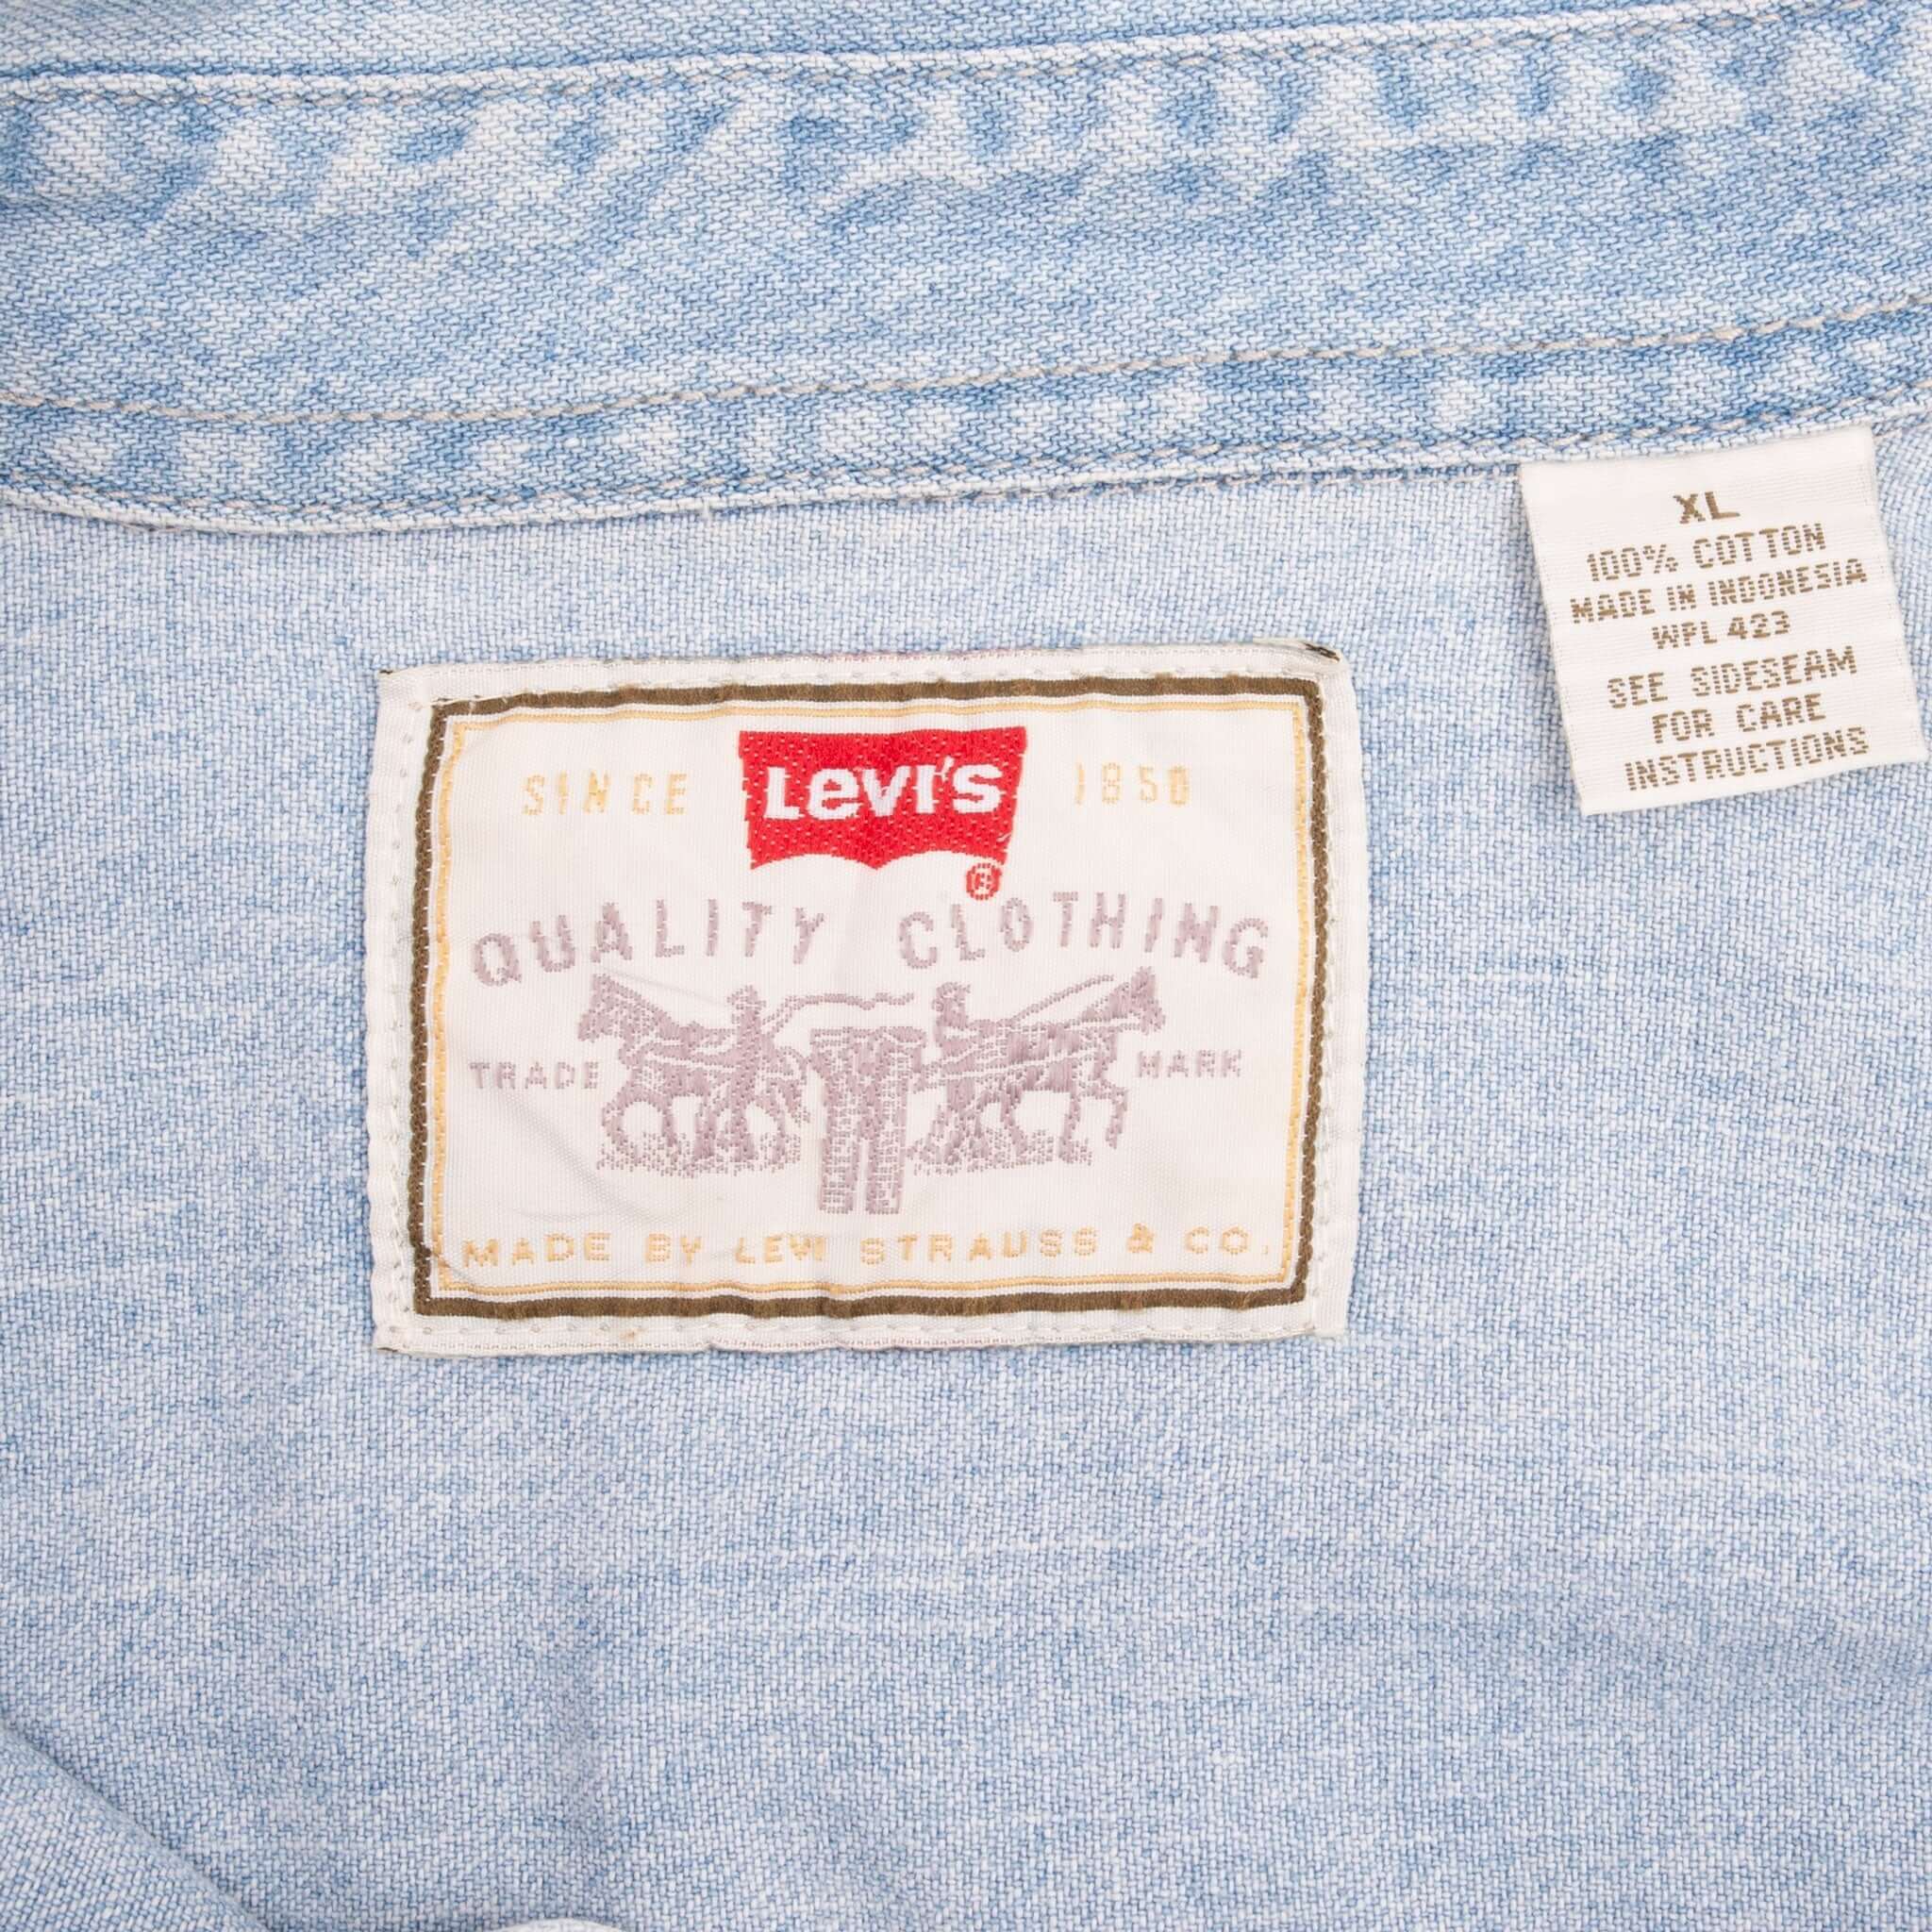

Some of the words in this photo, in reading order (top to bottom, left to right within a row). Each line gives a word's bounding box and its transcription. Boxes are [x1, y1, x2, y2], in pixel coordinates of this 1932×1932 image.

[1674, 491, 1740, 524] XL
[1587, 544, 1678, 581] 100%
[1693, 523, 1826, 569] COTTON
[1570, 589, 1656, 624] MADE
[1668, 584, 1696, 611] IN
[1707, 558, 1867, 607] INDONESIA
[1652, 621, 1717, 649] WPL
[1727, 610, 1790, 640] 423
[1607, 673, 1668, 708] SEE
[1690, 646, 1857, 696] SIDESEAM
[1652, 708, 1715, 743] FOR
[1736, 692, 1826, 732] CARE
[1624, 727, 1871, 791] INSTRUCTIONS
[522, 771, 689, 815] SINCE
[1074, 761, 1191, 806] 1850
[472, 898, 825, 987] QUALITY
[898, 891, 1269, 979] CLOTHING
[470, 1060, 599, 1090] TRADE
[1137, 1049, 1242, 1078] MARK
[462, 1232, 611, 1268] MADE
[644, 1233, 703, 1263] BY
[735, 1233, 826, 1264] LEVI
[859, 1225, 1098, 1265] STRAUSS
[1126, 1223, 1156, 1255] &
